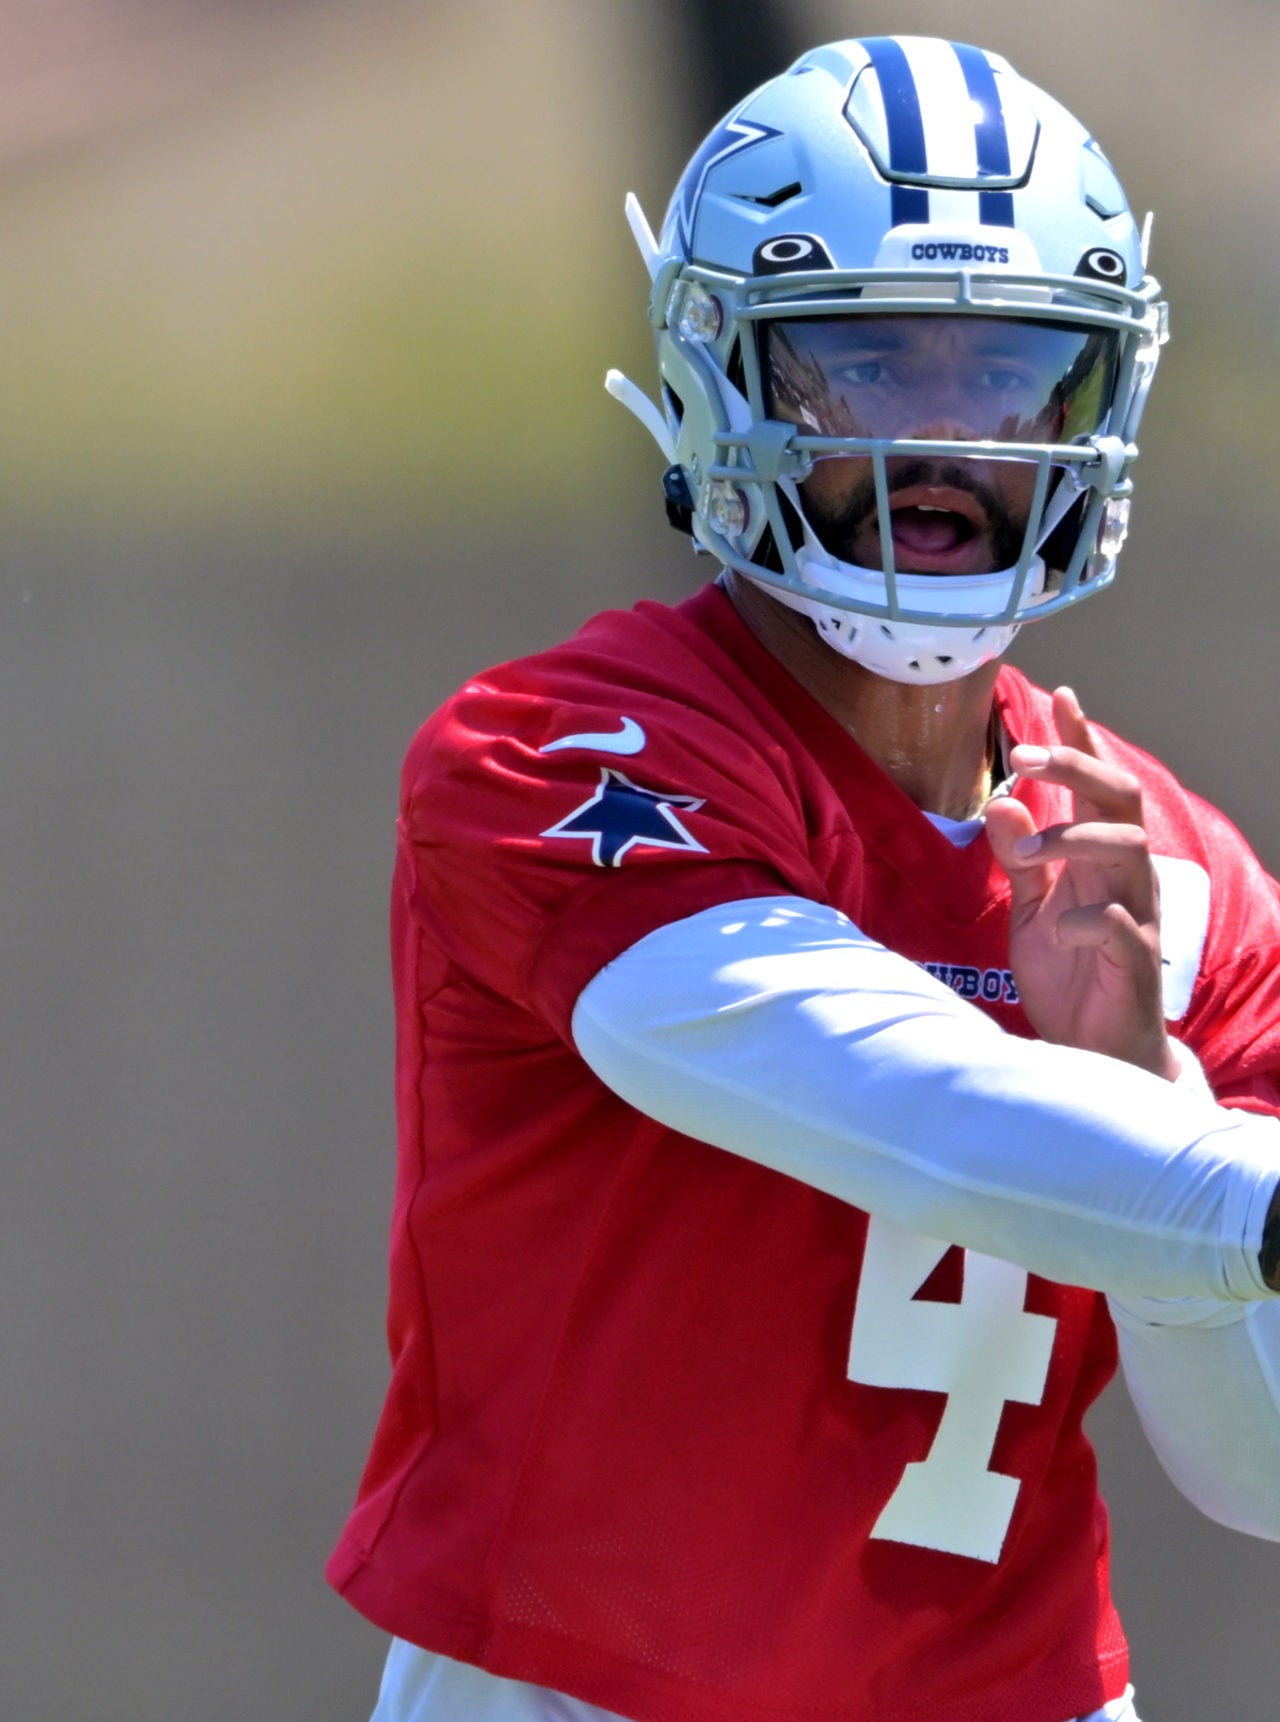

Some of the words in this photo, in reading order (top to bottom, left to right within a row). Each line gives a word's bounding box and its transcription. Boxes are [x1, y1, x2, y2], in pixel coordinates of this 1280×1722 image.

[911, 243, 1009, 264] COWBOYS
[912, 961, 1020, 1004] WBOY
[846, 1213, 1058, 1565] 4
